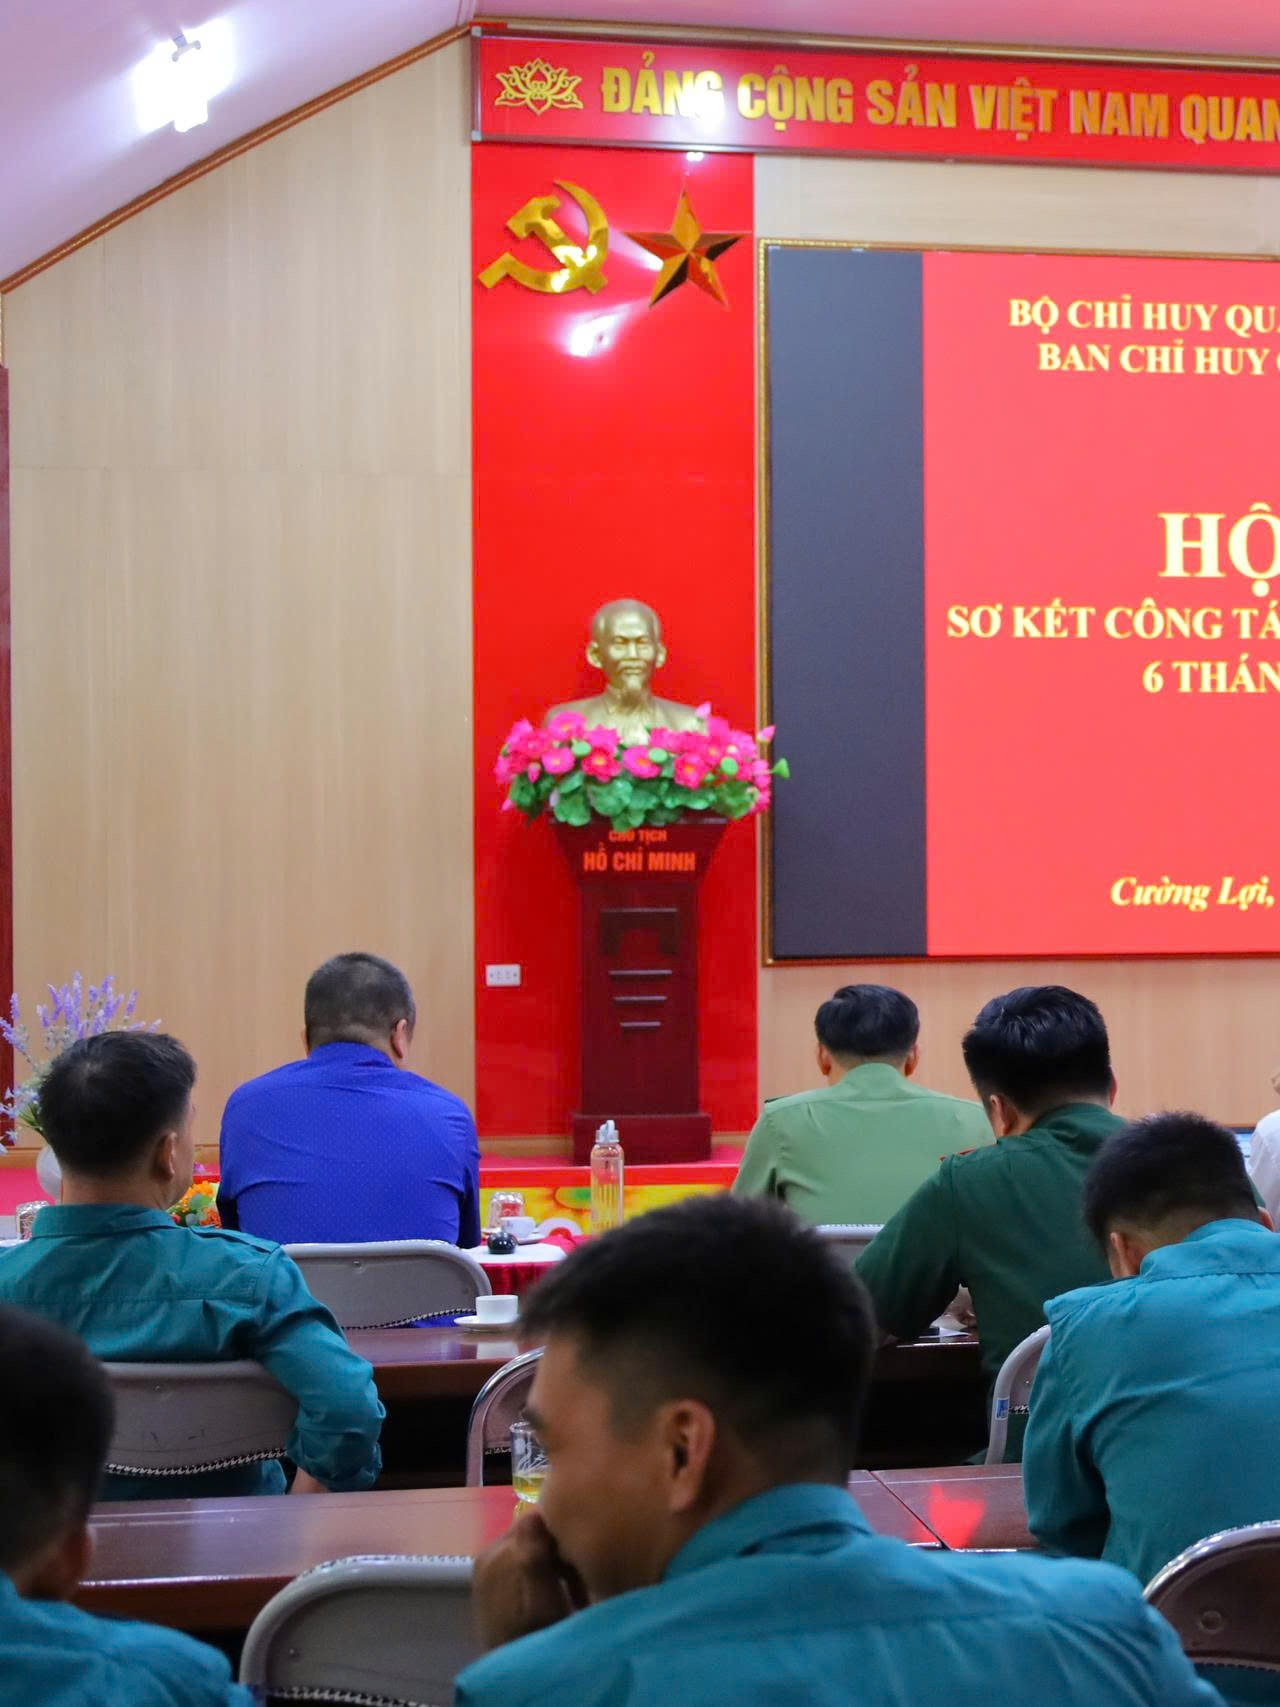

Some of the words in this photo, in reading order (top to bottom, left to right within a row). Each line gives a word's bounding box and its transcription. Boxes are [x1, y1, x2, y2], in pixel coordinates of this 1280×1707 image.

[600, 51, 726, 120] ĐẢNG
[737, 65, 855, 130] CỘNG
[866, 65, 957, 128] SẢN
[968, 77, 1058, 141] VIỆT
[1069, 90, 1169, 140] NAM
[1008, 295, 1060, 335] BỘ
[1067, 293, 1132, 330] CHỈ
[1142, 302, 1218, 332] HUY
[1037, 342, 1111, 372] BAN
[1118, 338, 1185, 374] CHỈ
[1194, 346, 1270, 376] HUY
[946, 602, 1003, 639] SƠ
[1012, 597, 1097, 639] KẾT
[1103, 597, 1223, 640] CÔNG
[1142, 660, 1164, 694] 6
[583, 842, 608, 871] HỒ
[613, 847, 643, 871] CHÍ
[648, 851, 696, 871] MINH
[1110, 875, 1211, 911] Cường
[1216, 875, 1275, 911] Lợi,
